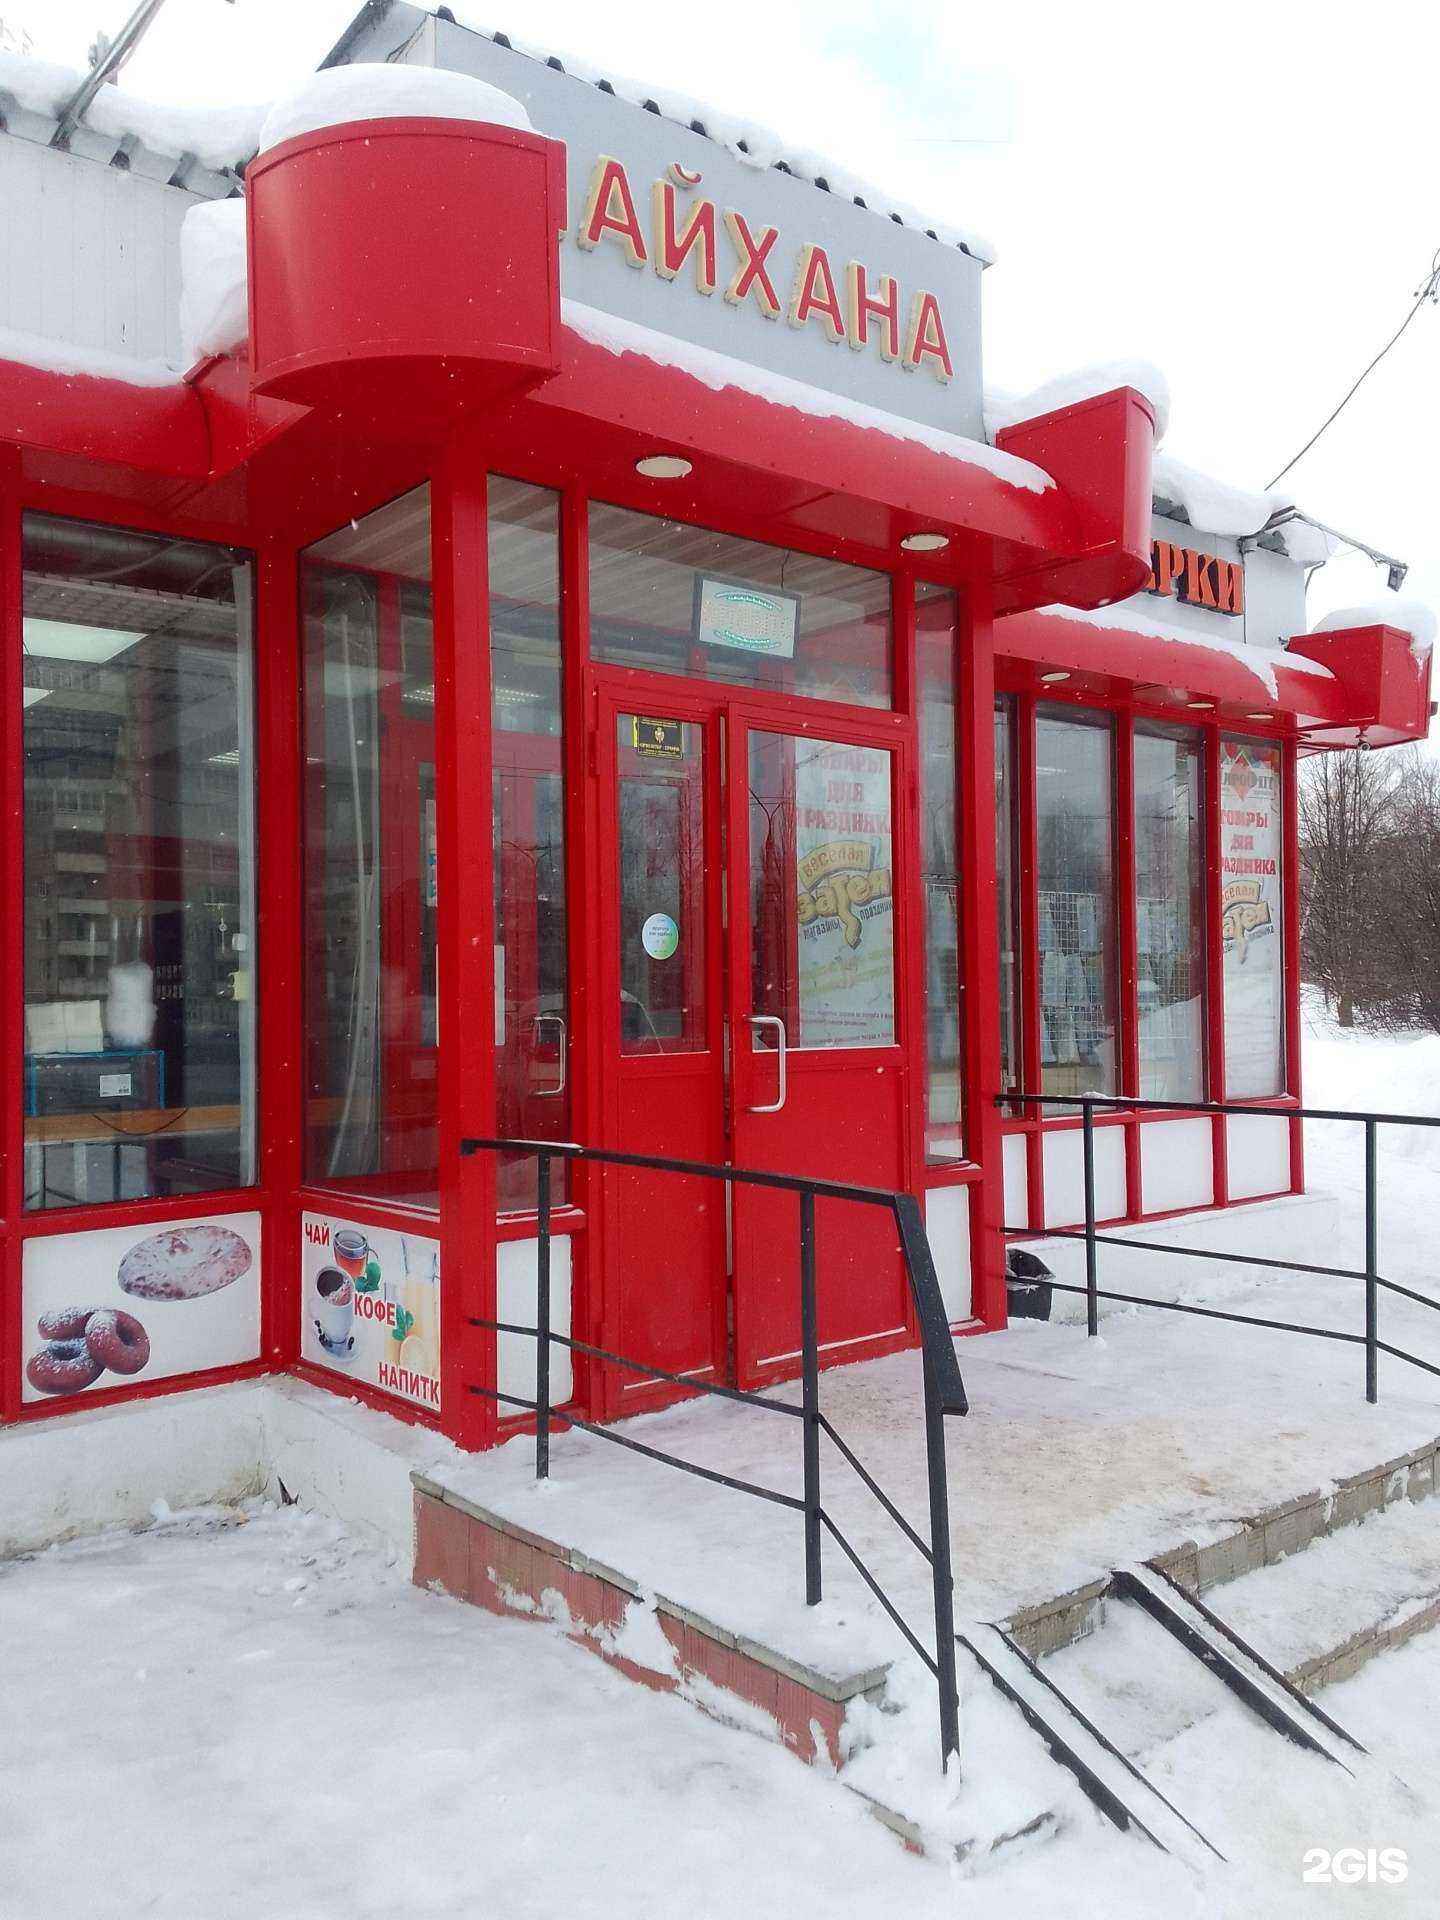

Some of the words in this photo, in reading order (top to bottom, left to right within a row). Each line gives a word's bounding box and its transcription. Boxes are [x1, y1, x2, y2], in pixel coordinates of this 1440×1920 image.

[560, 154, 956, 384] АЙХАНА
[1149, 540, 1244, 616] РКИ
[305, 1222, 330, 1246] ЧАЙ
[354, 1294, 396, 1326] КОФЕ
